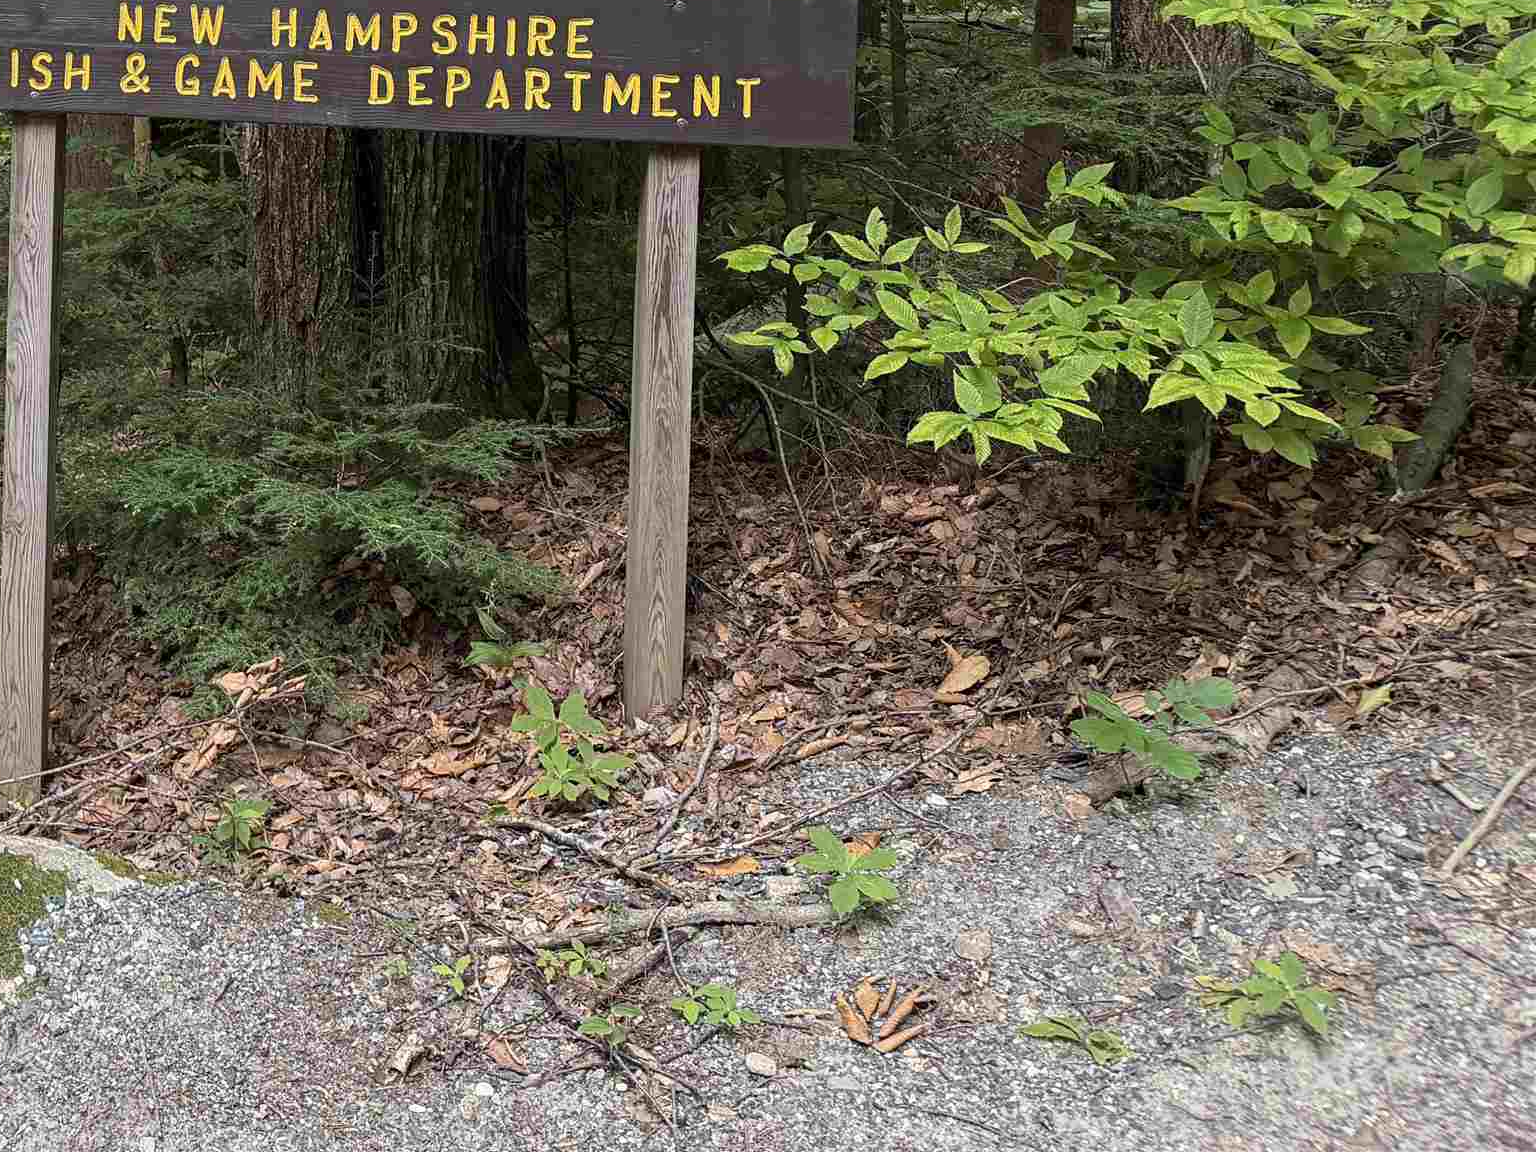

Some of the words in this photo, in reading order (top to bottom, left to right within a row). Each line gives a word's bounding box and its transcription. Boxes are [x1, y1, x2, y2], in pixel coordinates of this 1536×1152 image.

[117, 4, 224, 45] NEW
[272, 8, 593, 59] HAMPSHIRE
[120, 52, 151, 94] &
[176, 53, 321, 104] GAME
[368, 63, 760, 119] DEPARTMENT
